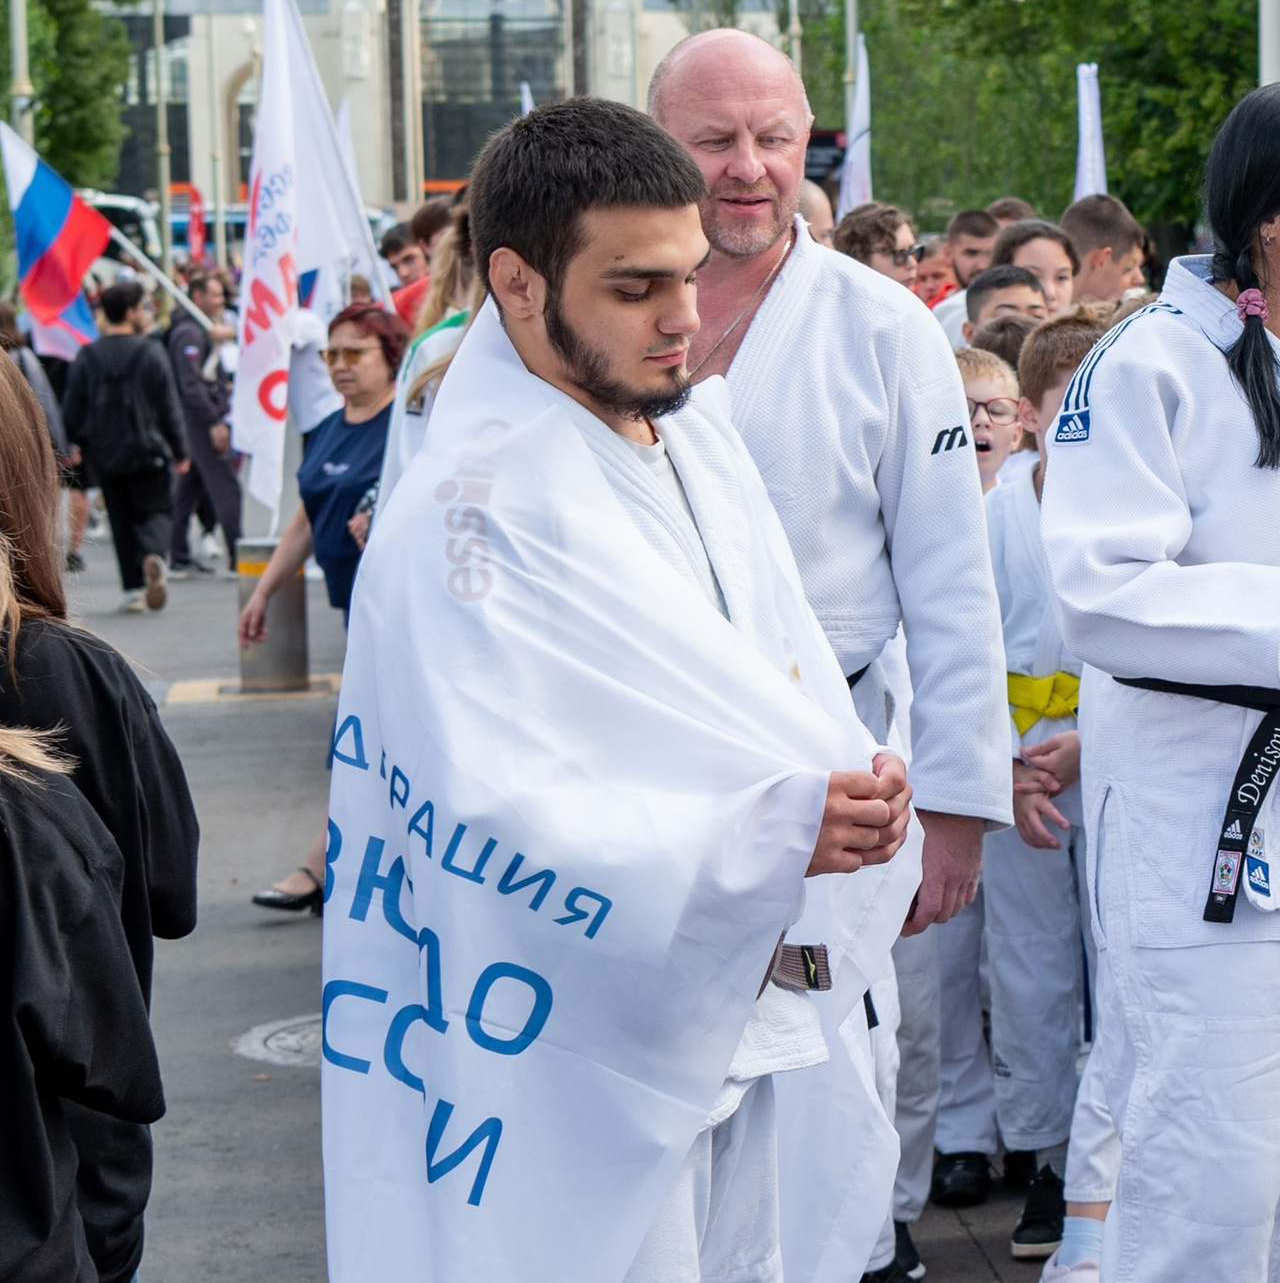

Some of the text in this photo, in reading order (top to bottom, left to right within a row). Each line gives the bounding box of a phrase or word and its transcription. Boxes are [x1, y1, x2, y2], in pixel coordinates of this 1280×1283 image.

[1057, 429, 1088, 440] adidas
[1223, 831, 1244, 840] adidas
[1249, 875, 1270, 890] adidas
